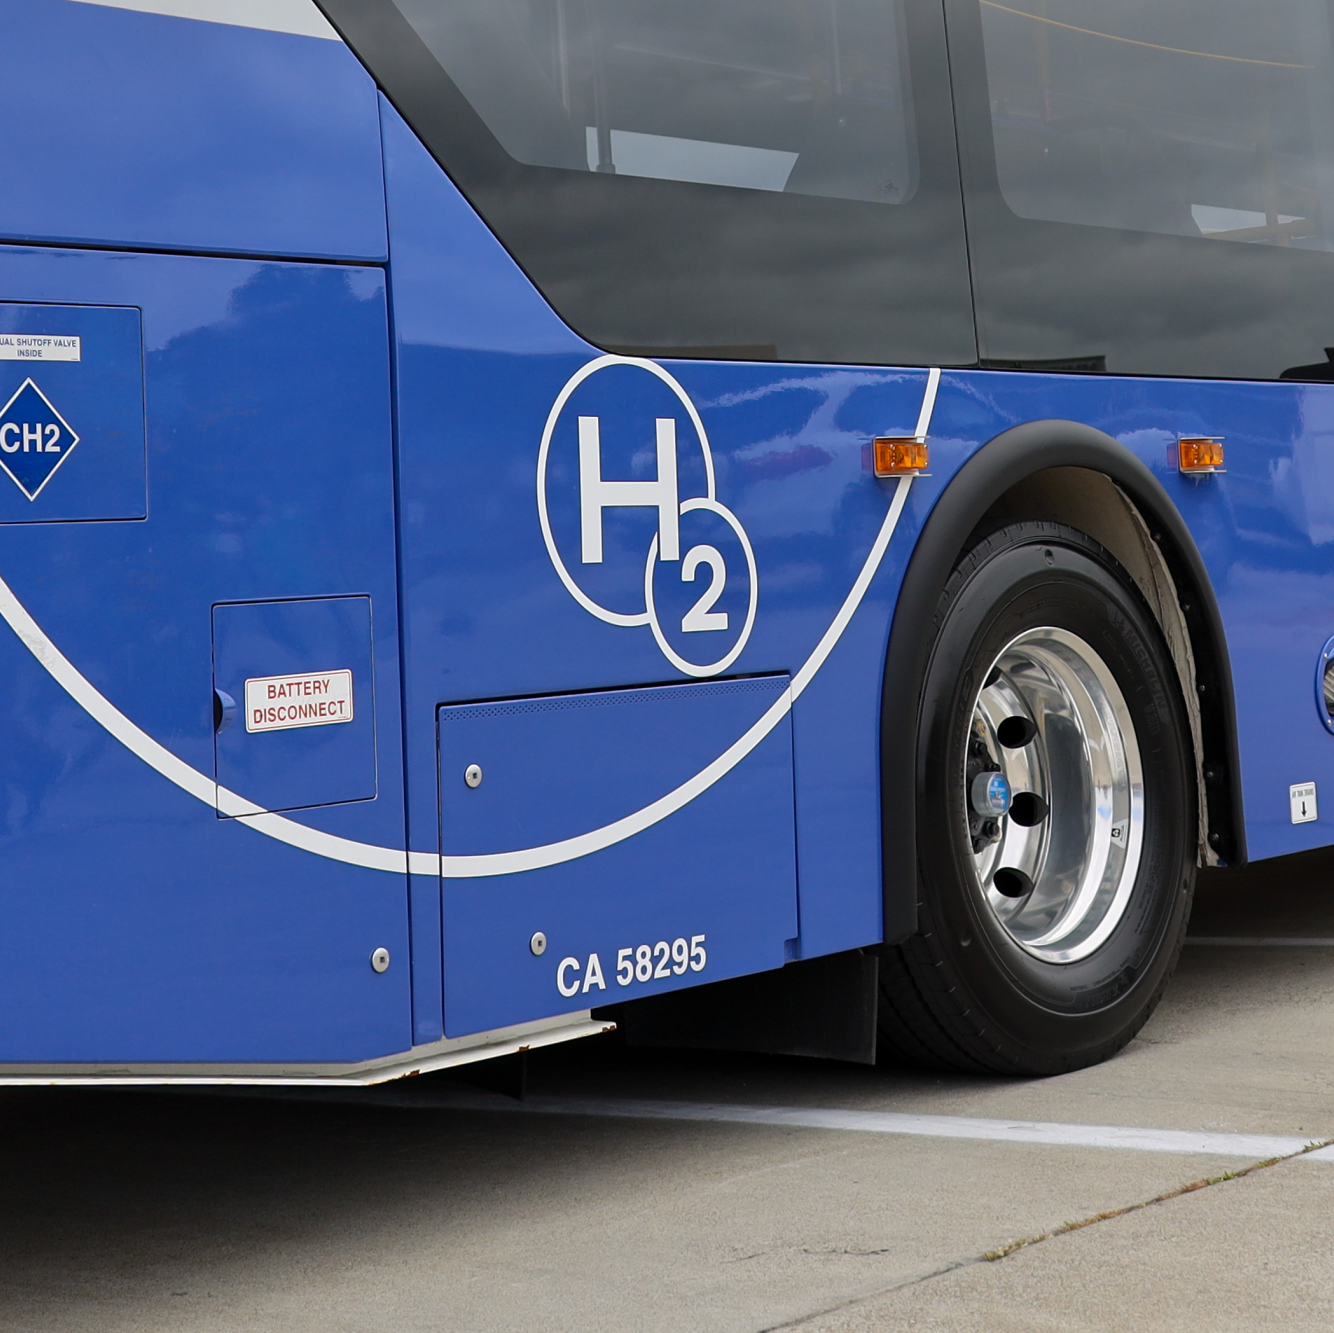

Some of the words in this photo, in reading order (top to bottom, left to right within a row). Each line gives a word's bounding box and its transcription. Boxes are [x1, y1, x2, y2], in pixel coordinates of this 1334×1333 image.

[16, 338, 52, 346] SHUTOFF
[53, 339, 77, 347] VALVE
[17, 349, 43, 358] INSIDE
[0, 422, 61, 453] CH2
[267, 679, 330, 699] BATTERY
[253, 700, 345, 724] DISCONNECT
[556, 952, 607, 998] CA
[616, 933, 707, 987] 58295
